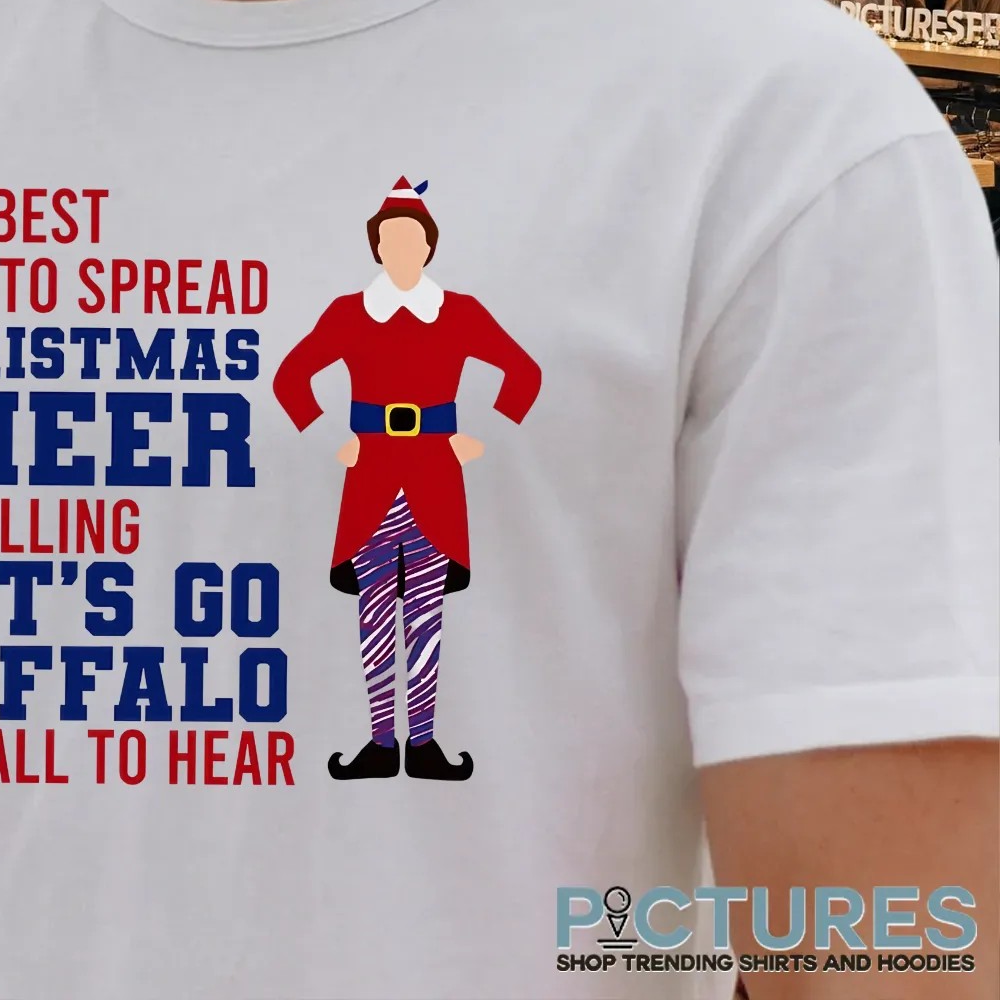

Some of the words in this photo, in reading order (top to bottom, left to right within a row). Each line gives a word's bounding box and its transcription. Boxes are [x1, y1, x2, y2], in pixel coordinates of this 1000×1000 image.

[78, 258, 268, 314] SPREAD
[174, 561, 280, 638] GO
[87, 729, 147, 786] TO
[168, 730, 295, 786] HEAR
